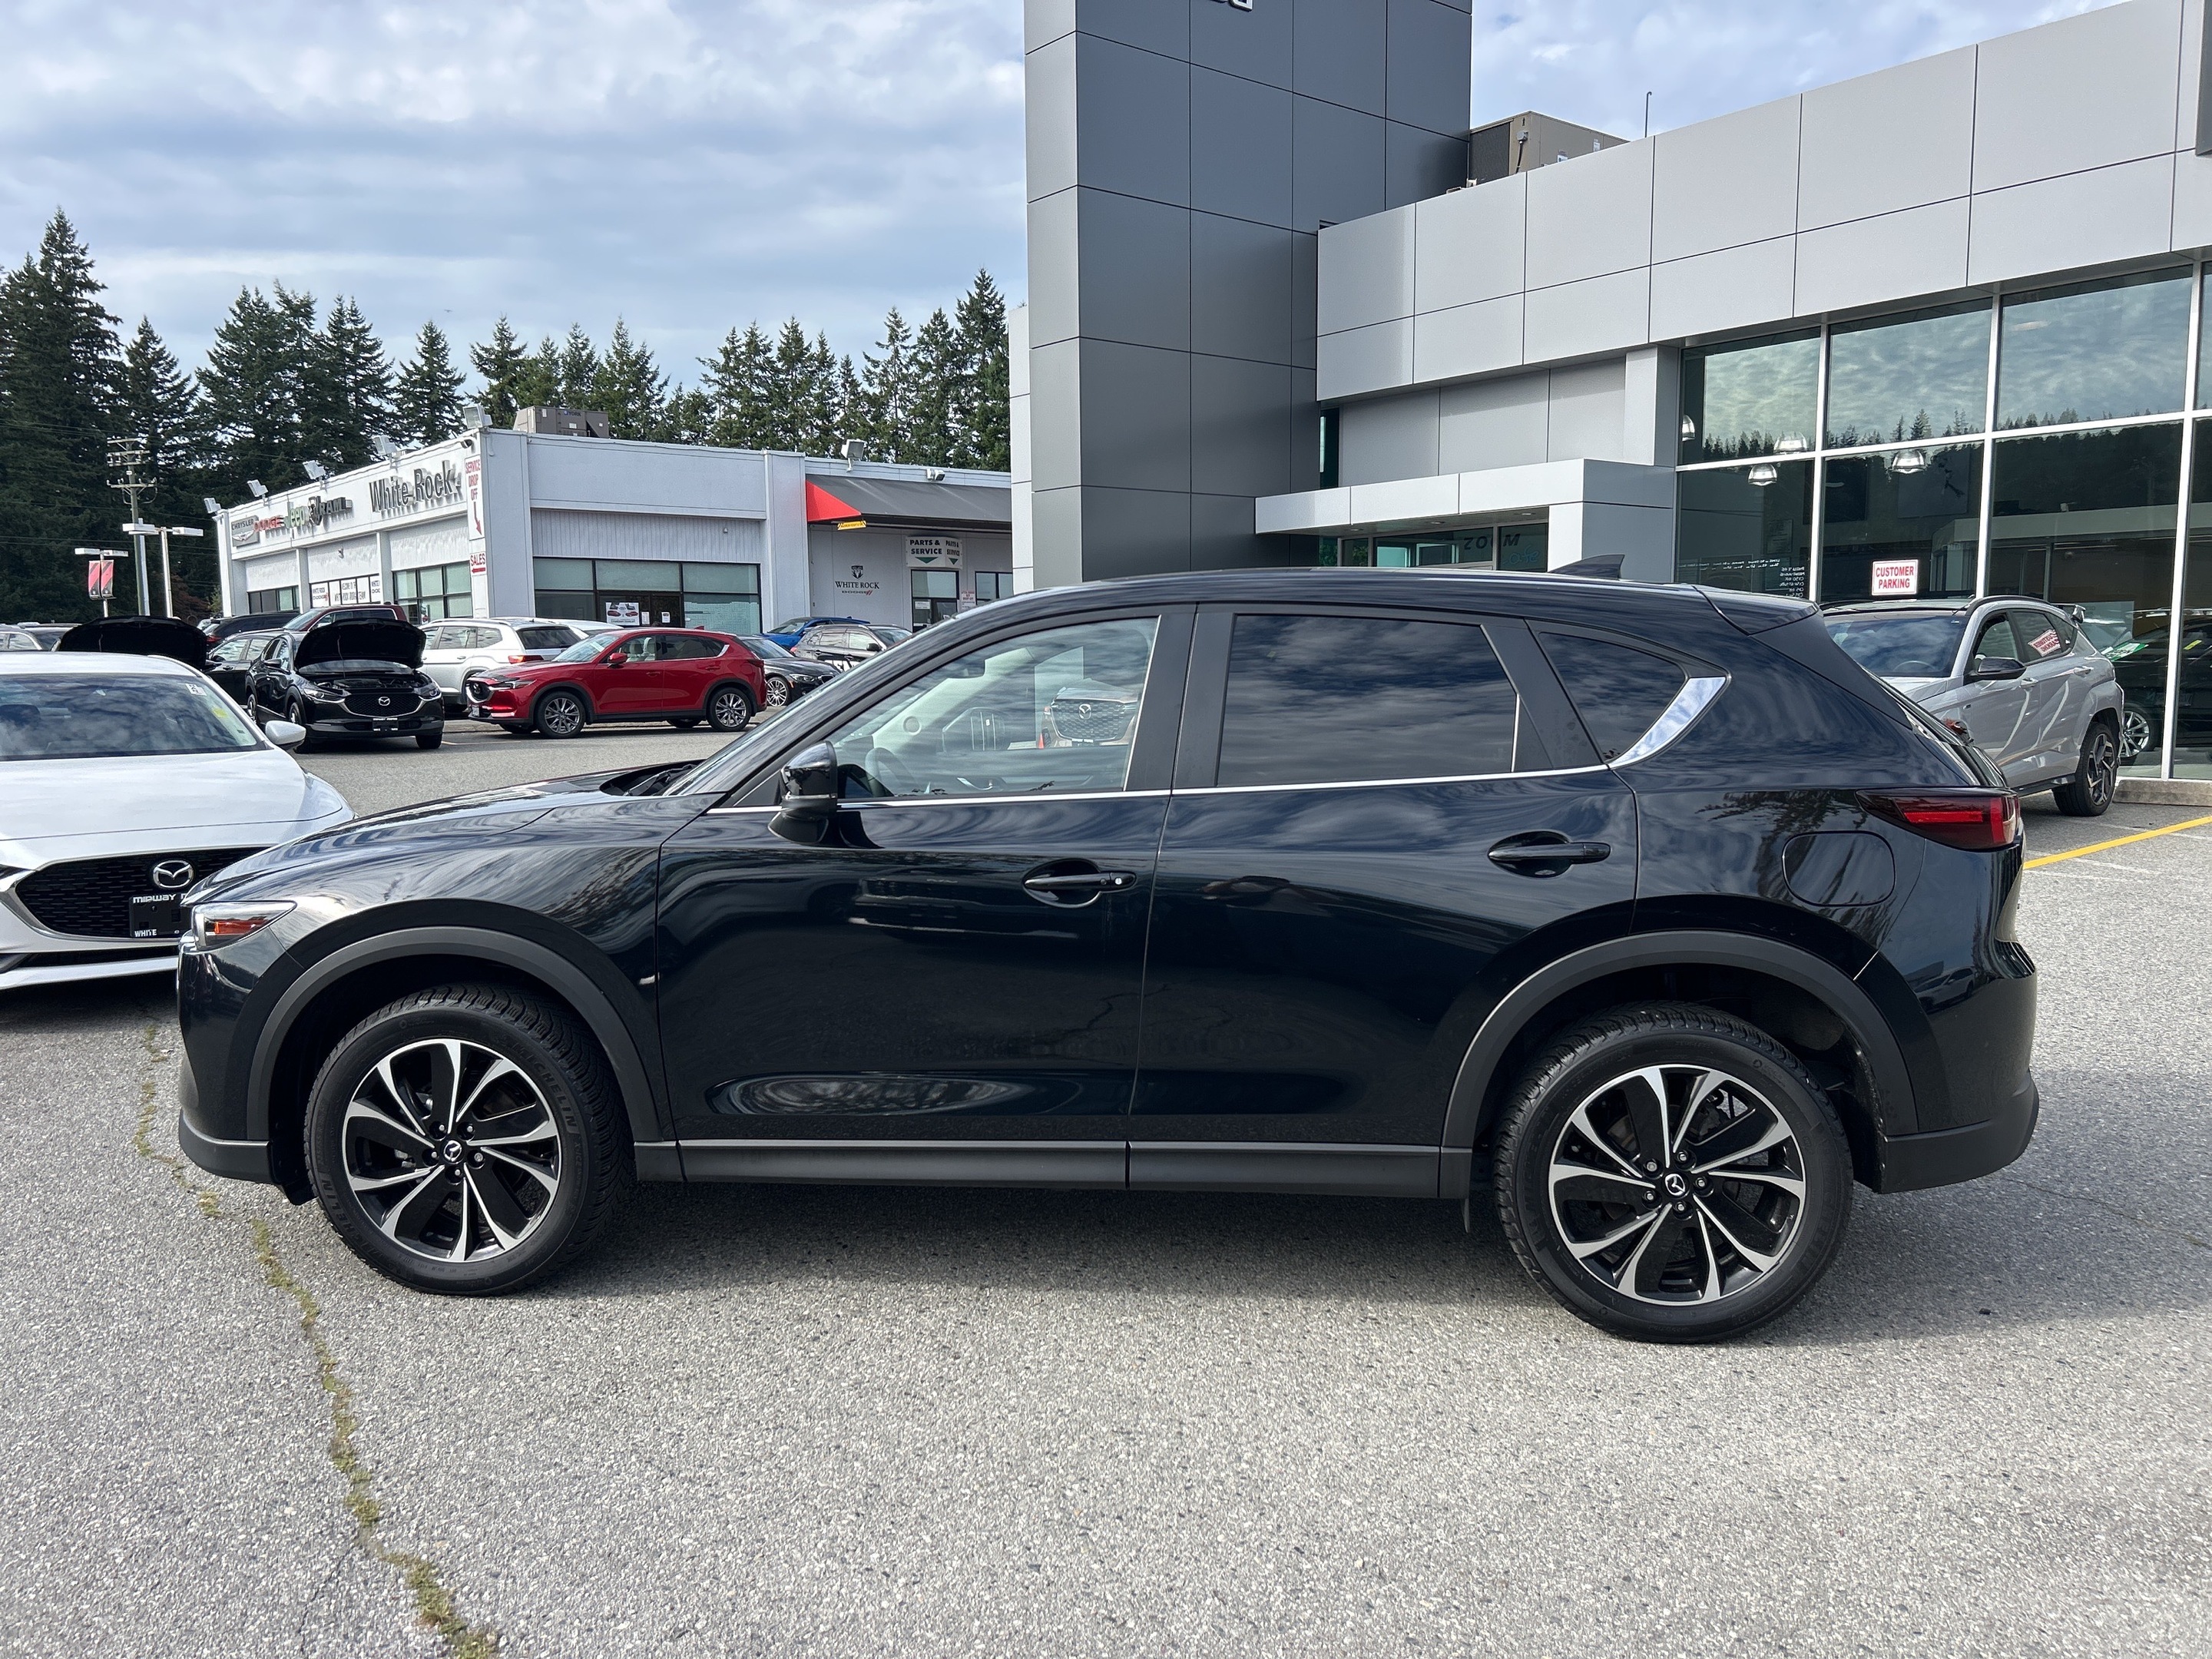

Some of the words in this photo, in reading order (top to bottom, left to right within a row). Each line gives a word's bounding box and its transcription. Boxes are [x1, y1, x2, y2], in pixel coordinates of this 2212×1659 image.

[465, 459, 481, 474] SERVICE
[369, 475, 410, 512] White
[414, 460, 455, 502] Rock
[469, 474, 478, 487] DROP
[320, 497, 346, 515] RAM
[283, 502, 306, 528] Jeep
[231, 518, 254, 530] CHRYSLER
[1463, 533, 1521, 550] ZOM
[470, 553, 486, 566] SALES
[1876, 566, 1914, 577] CUSTOMER
[1878, 578, 1910, 589] PARKING
[134, 929, 157, 938] WHITE
[511, 1041, 578, 1128] MICHELIN
